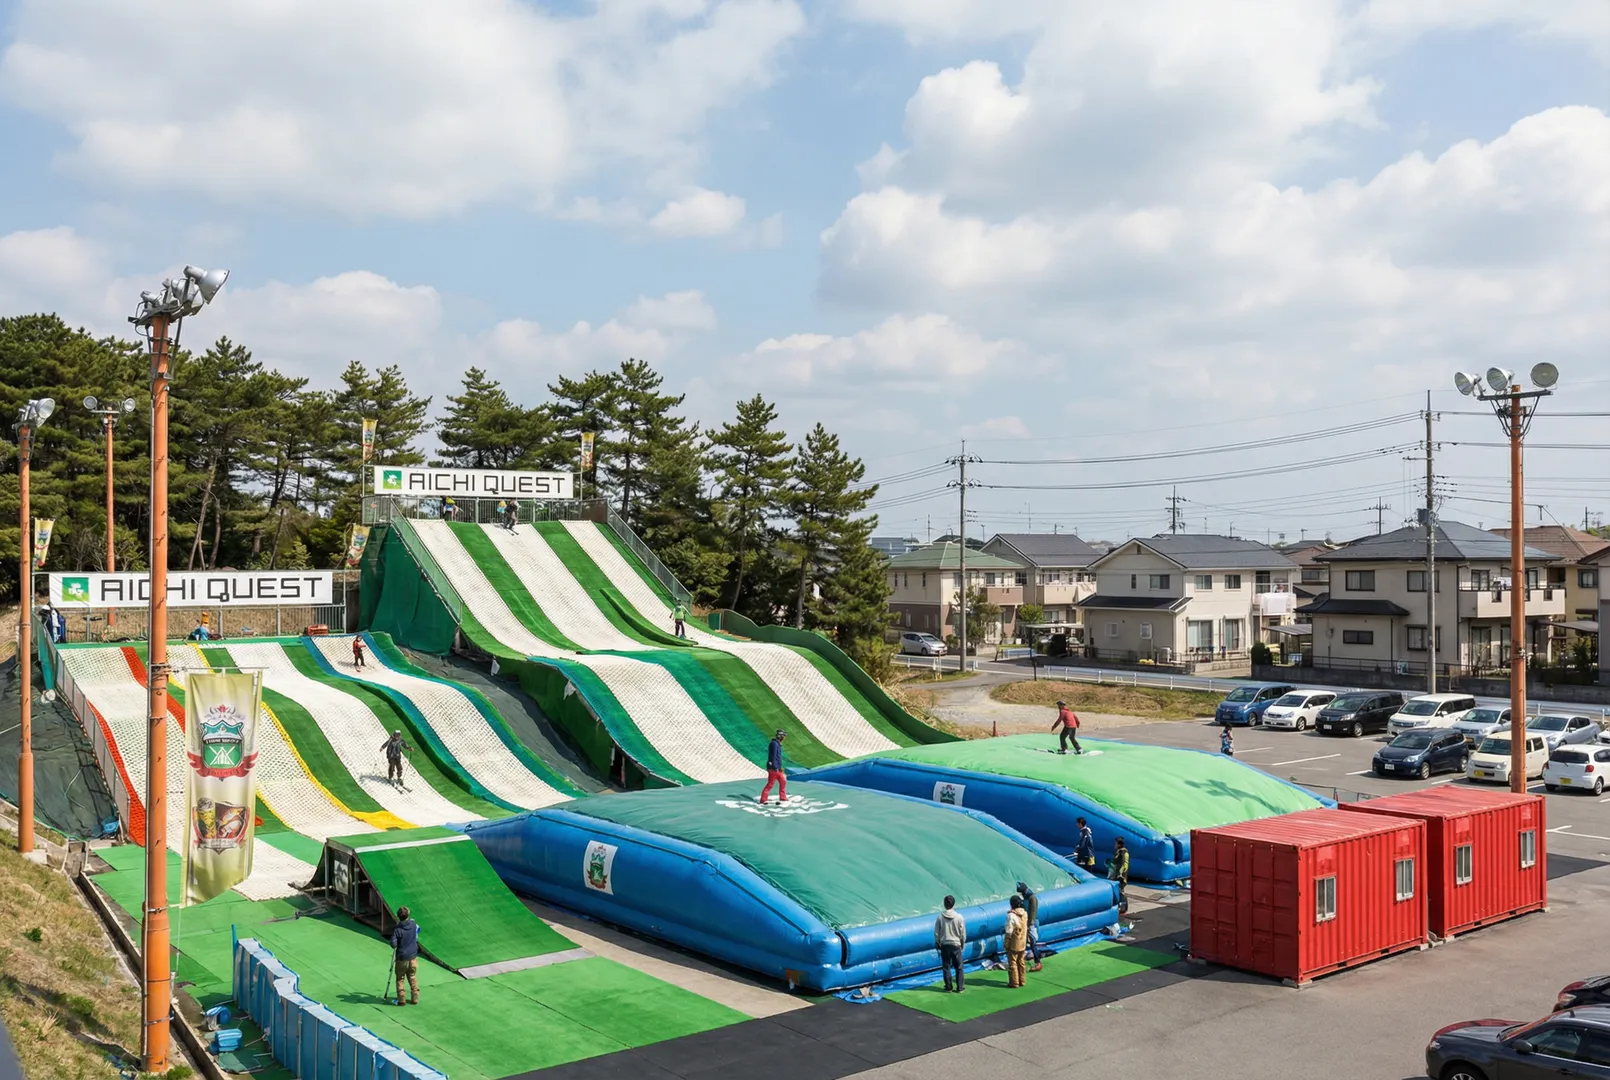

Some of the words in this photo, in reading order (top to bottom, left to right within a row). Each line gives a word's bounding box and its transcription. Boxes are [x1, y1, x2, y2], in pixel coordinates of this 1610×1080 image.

[409, 473, 475, 492] AICHI
[484, 475, 565, 494] QUEST
[207, 577, 323, 602] QUEST
